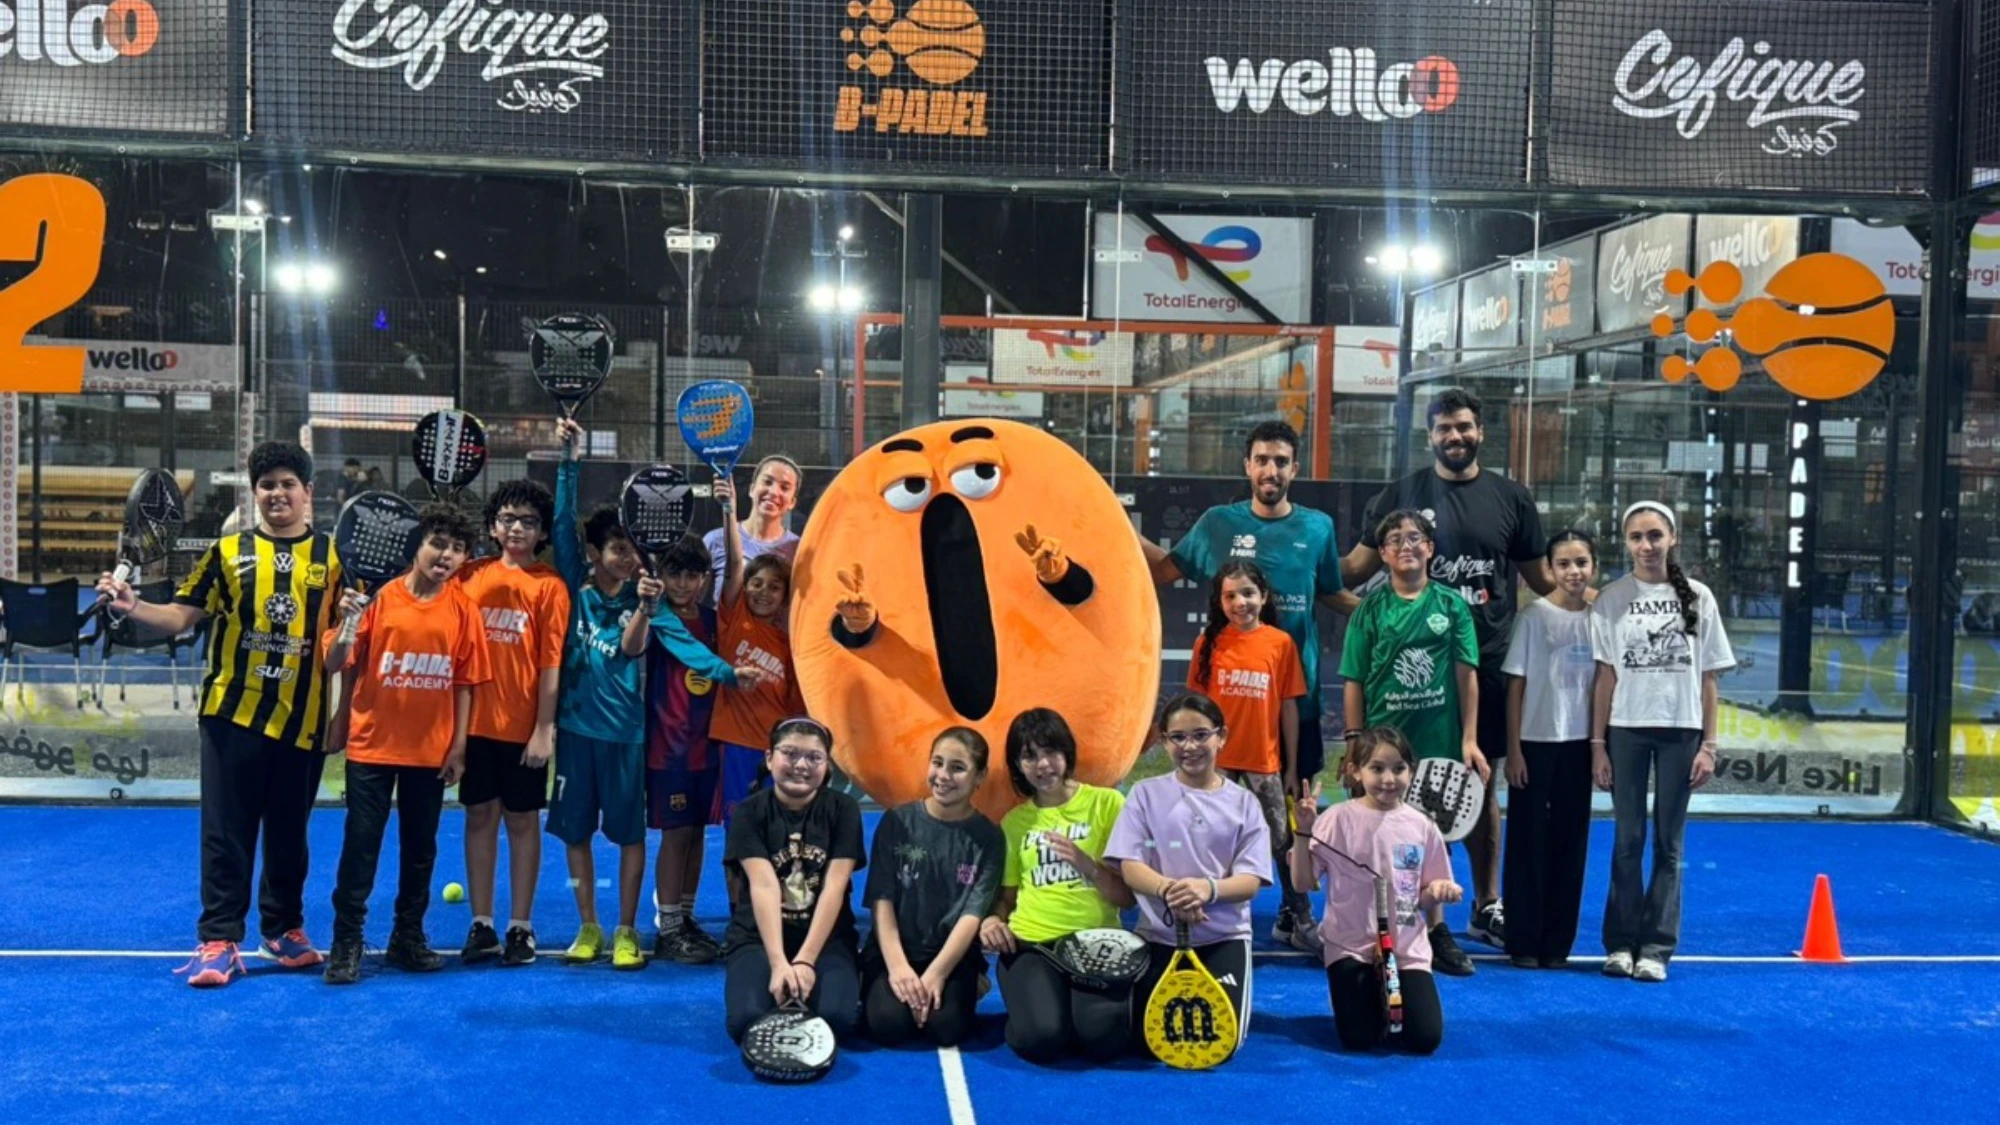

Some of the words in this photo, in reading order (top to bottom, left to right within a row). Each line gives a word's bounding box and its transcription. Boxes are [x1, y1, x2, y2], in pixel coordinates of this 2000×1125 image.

[834, 86, 988, 137] B-PADEL
[0, 173, 108, 394] 2
[1431, 555, 1494, 583] Cofique
[1629, 600, 1682, 615] BAMB
[382, 676, 453, 690] ACADEMY
[1386, 702, 1402, 711] Red
